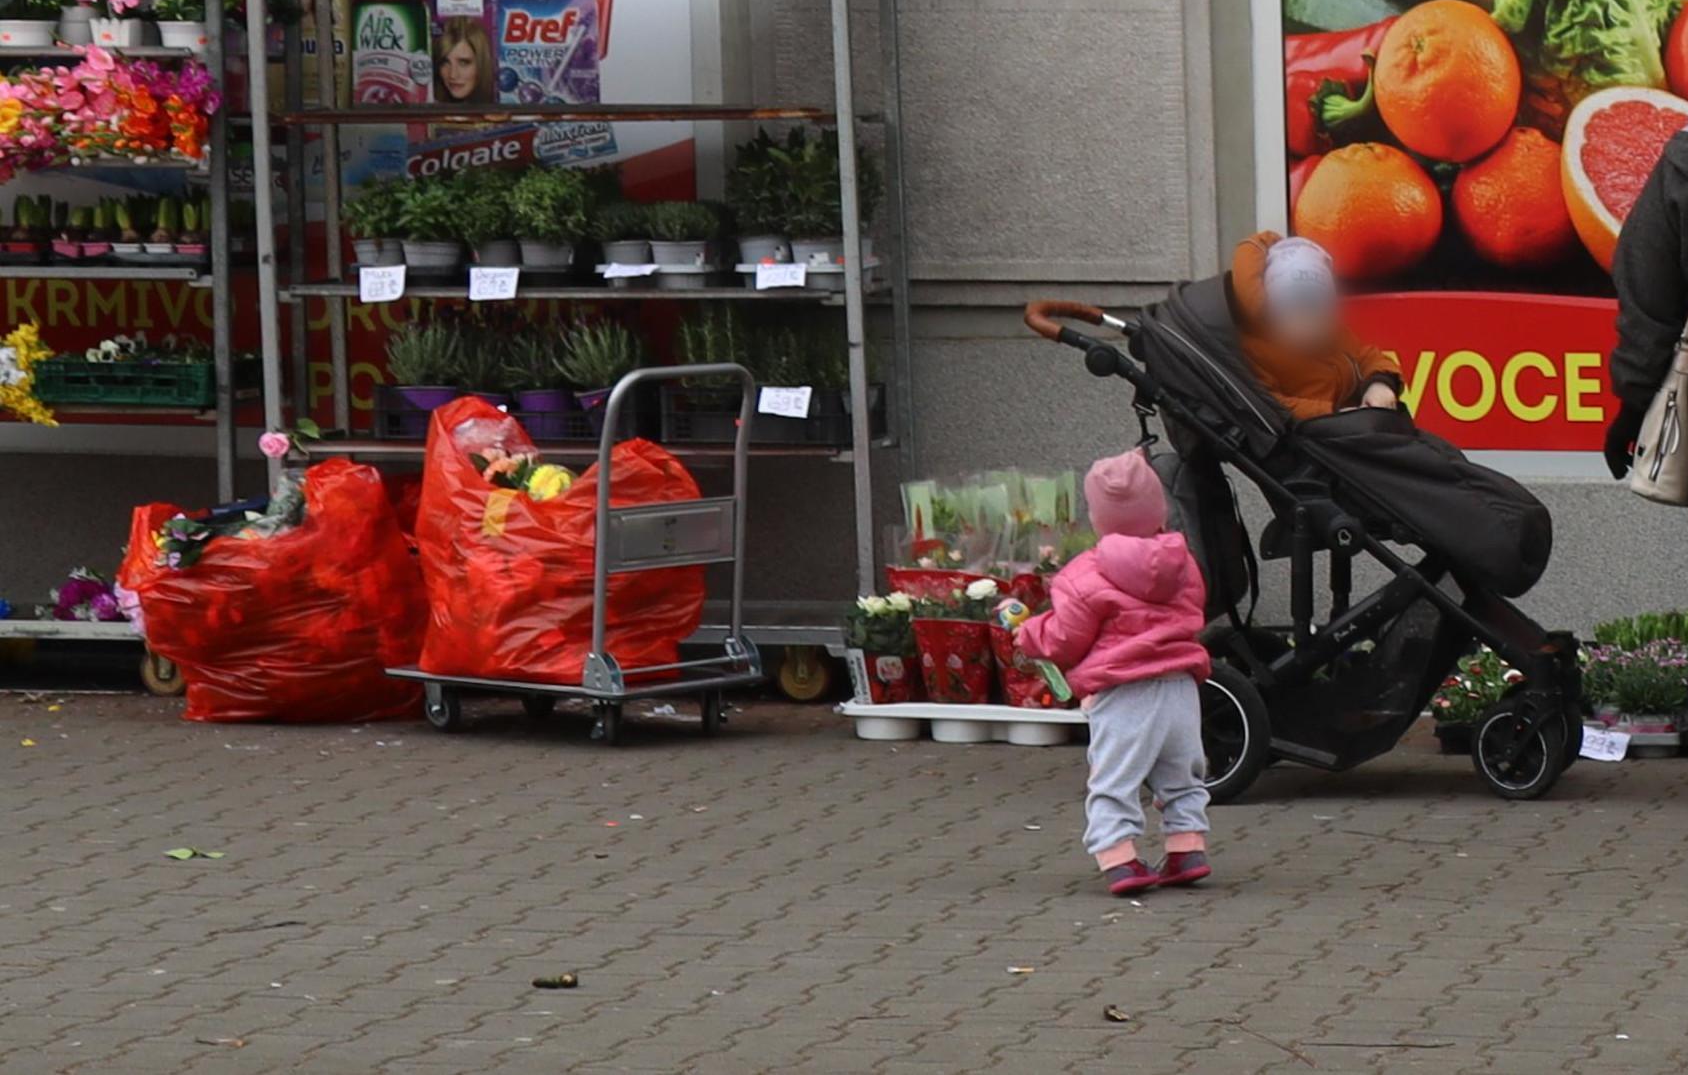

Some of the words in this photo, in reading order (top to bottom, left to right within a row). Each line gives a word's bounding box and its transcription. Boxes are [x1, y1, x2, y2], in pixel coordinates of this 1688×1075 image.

[504, 10, 577, 43] Bref
[405, 138, 522, 179] Colgate
[1382, 350, 1604, 422] VOCE
